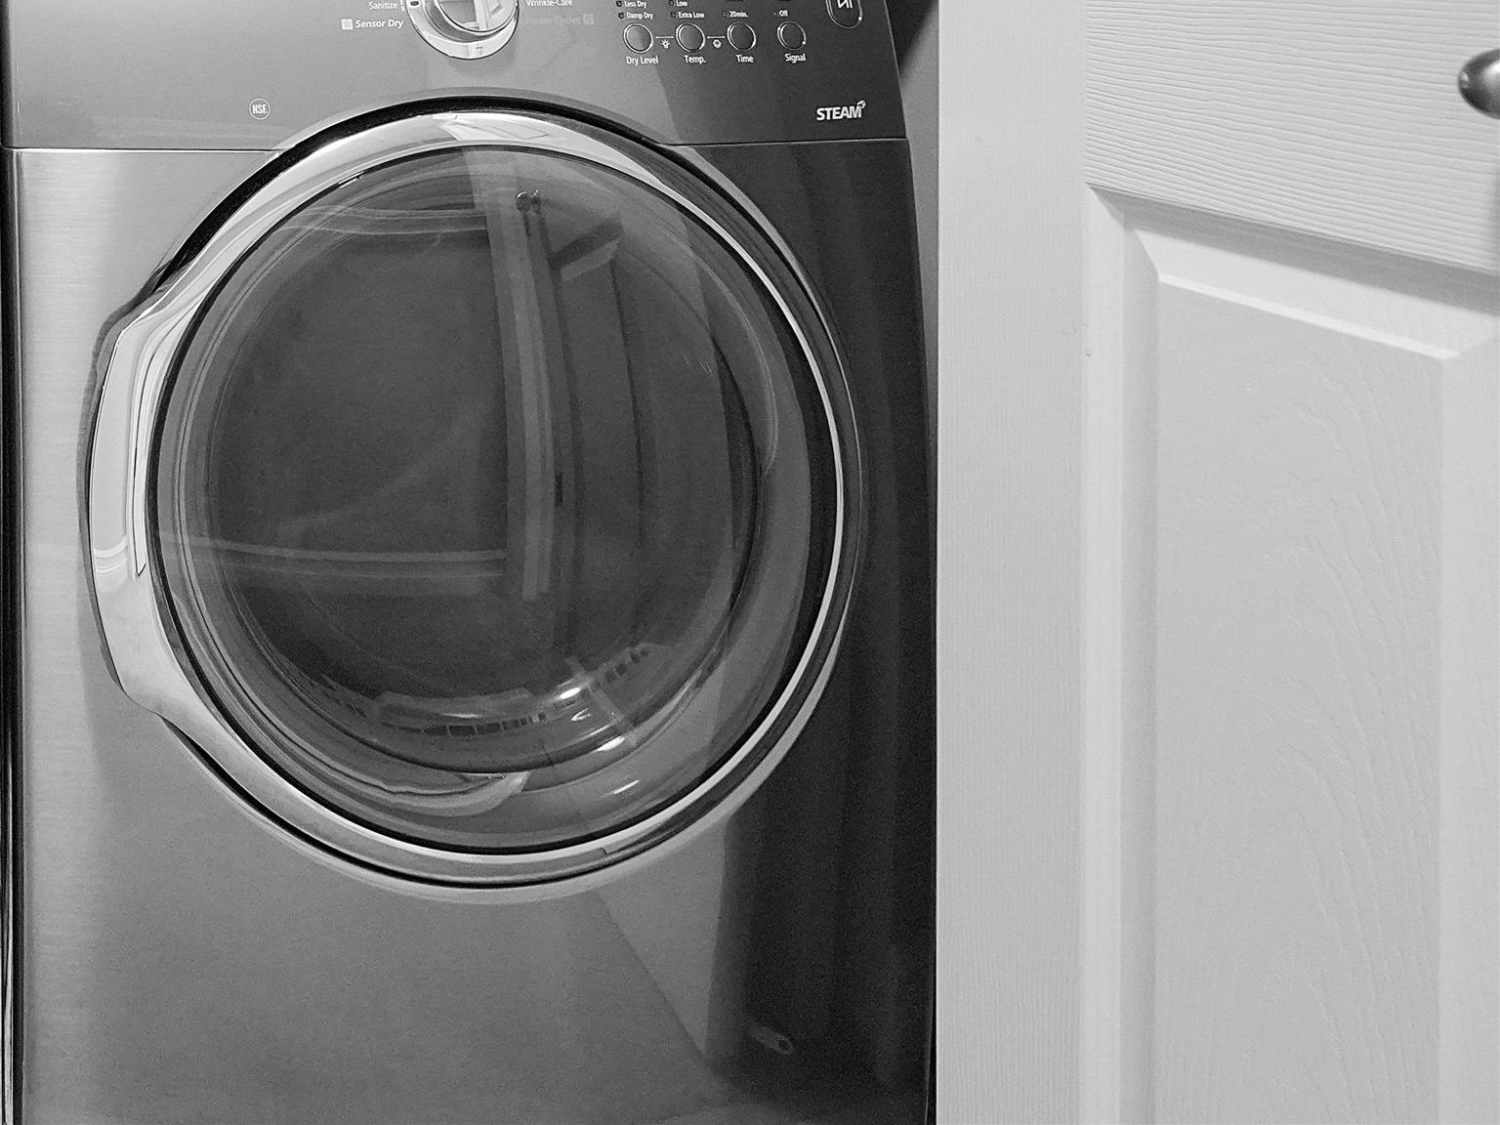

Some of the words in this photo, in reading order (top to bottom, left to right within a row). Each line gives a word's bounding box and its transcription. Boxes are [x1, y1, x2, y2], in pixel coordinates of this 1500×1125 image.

[368, 1, 399, 10] Sanitize
[636, 0, 647, 9] Dry
[626, 12, 643, 20] Damp
[643, 12, 654, 21] Dry
[678, 11, 693, 19] Extra
[779, 9, 789, 17] Off
[355, 19, 386, 28] Sensor
[387, 18, 405, 29] Dry
[625, 56, 639, 66] Dry
[640, 55, 659, 64] Level
[683, 54, 707, 65] Temp.
[735, 54, 755, 63] Time
[784, 53, 807, 64] Signal
[252, 104, 267, 114] NSF
[816, 105, 863, 121] STEAM
